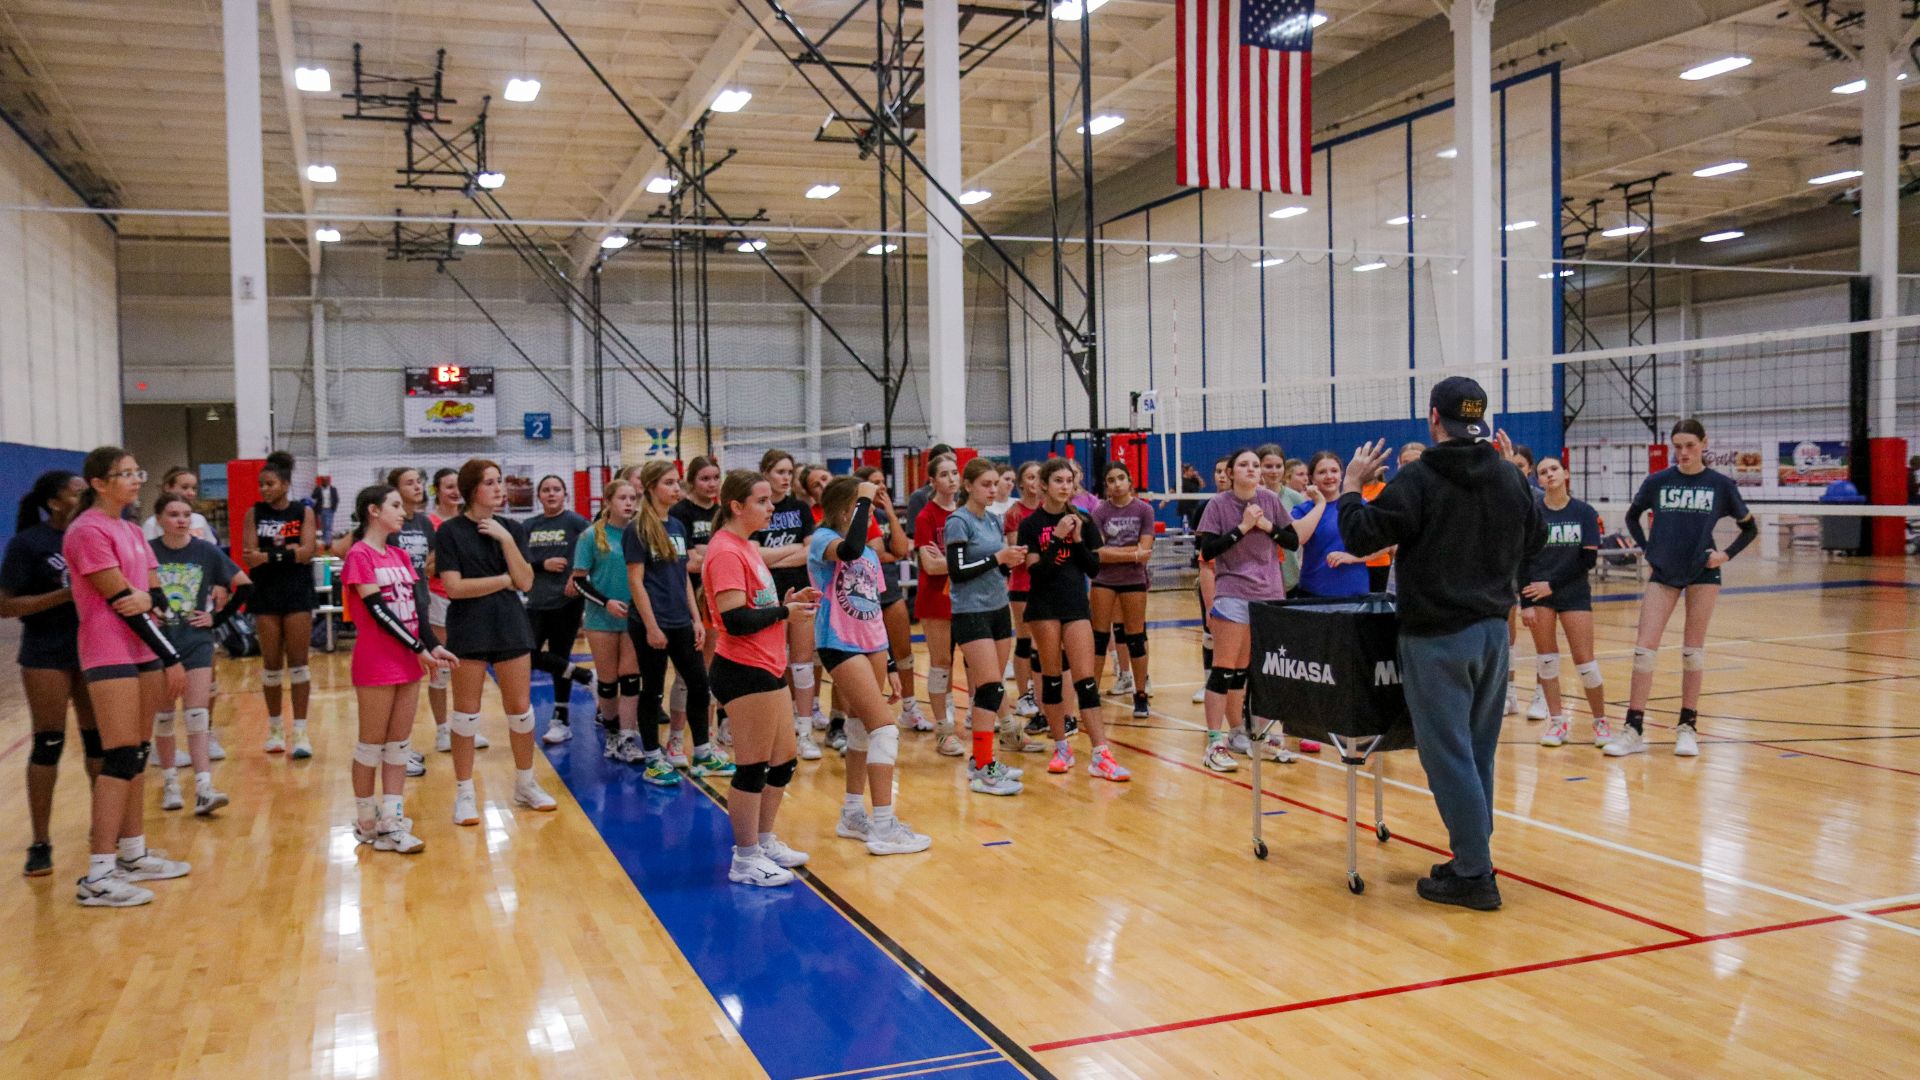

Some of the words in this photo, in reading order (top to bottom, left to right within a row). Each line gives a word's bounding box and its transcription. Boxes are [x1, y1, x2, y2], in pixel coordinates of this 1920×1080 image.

[438, 366, 461, 382] 62
[1143, 399, 1156, 411] 5A
[532, 421, 544, 437] 2
[764, 532, 796, 547] beta
[836, 590, 860, 617] SOUTH
